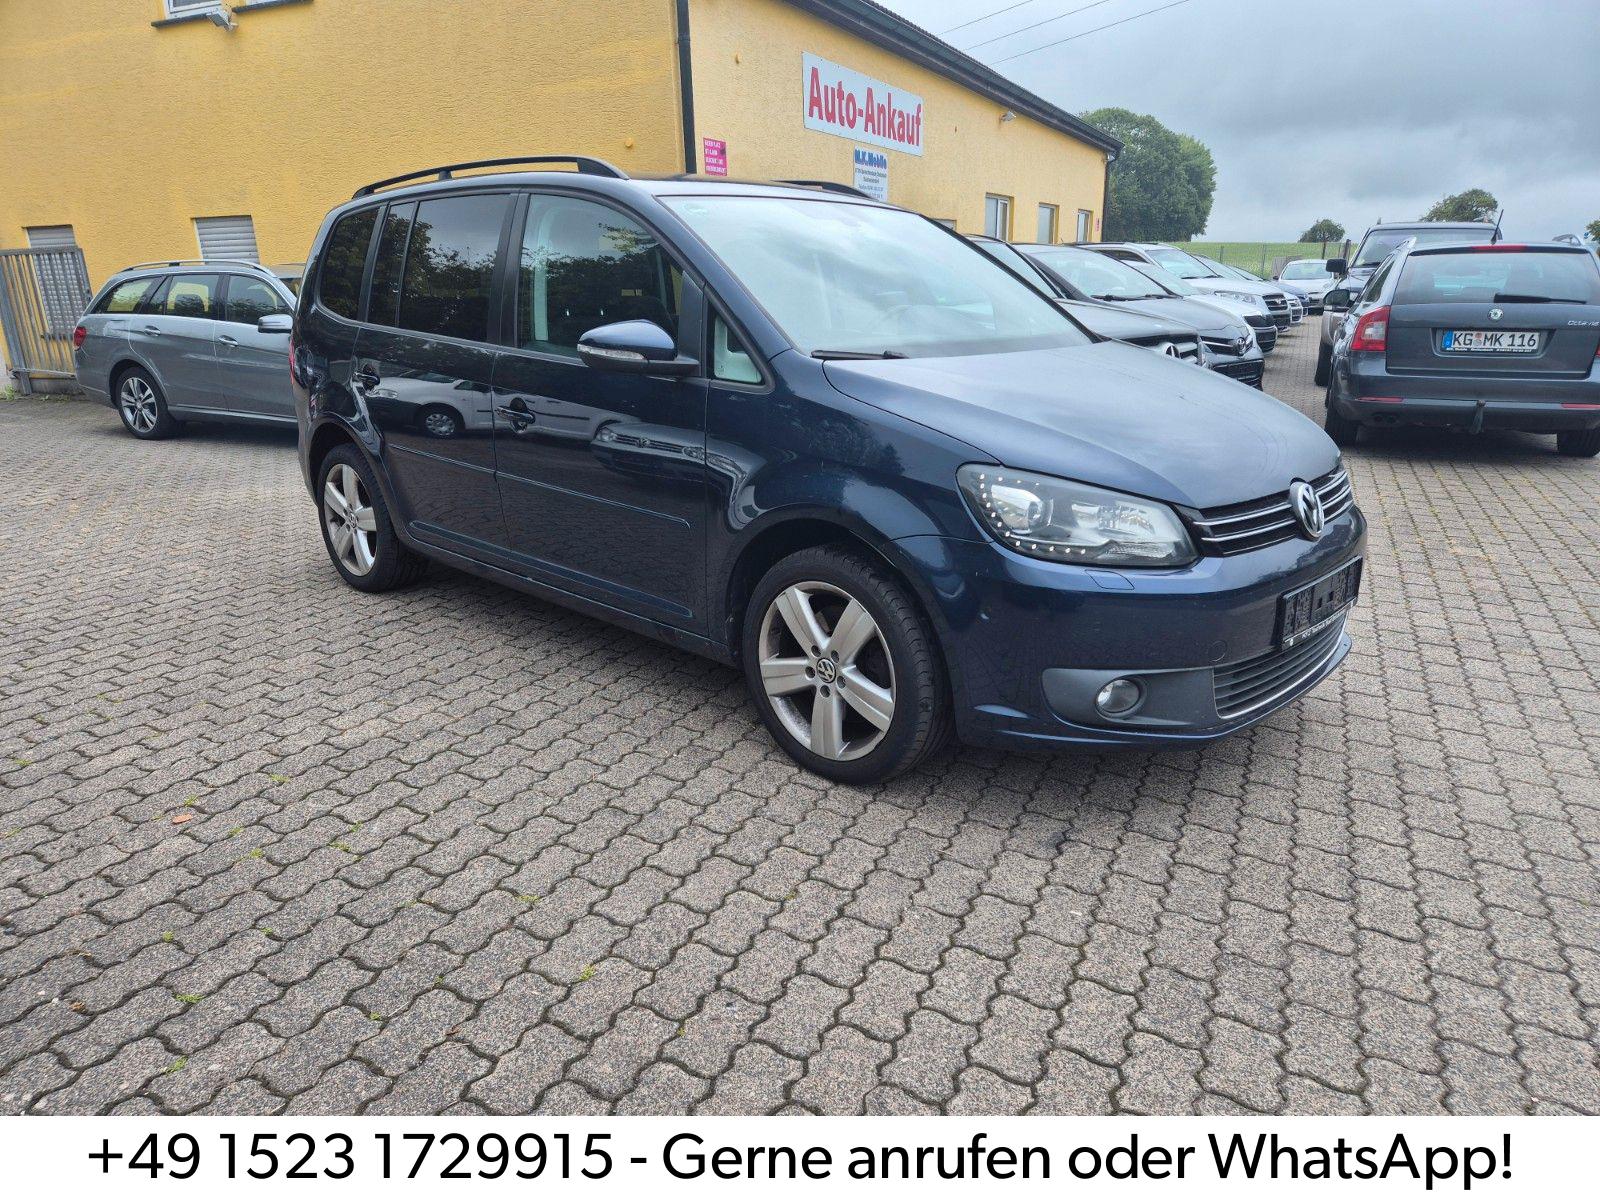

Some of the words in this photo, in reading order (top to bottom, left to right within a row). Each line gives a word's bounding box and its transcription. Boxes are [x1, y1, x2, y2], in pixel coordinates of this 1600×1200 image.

[808, 66, 922, 147] Auto-Ankauf
[1453, 332, 1474, 346] KG
[1483, 333, 1504, 347] MK
[1507, 333, 1537, 348] 116
